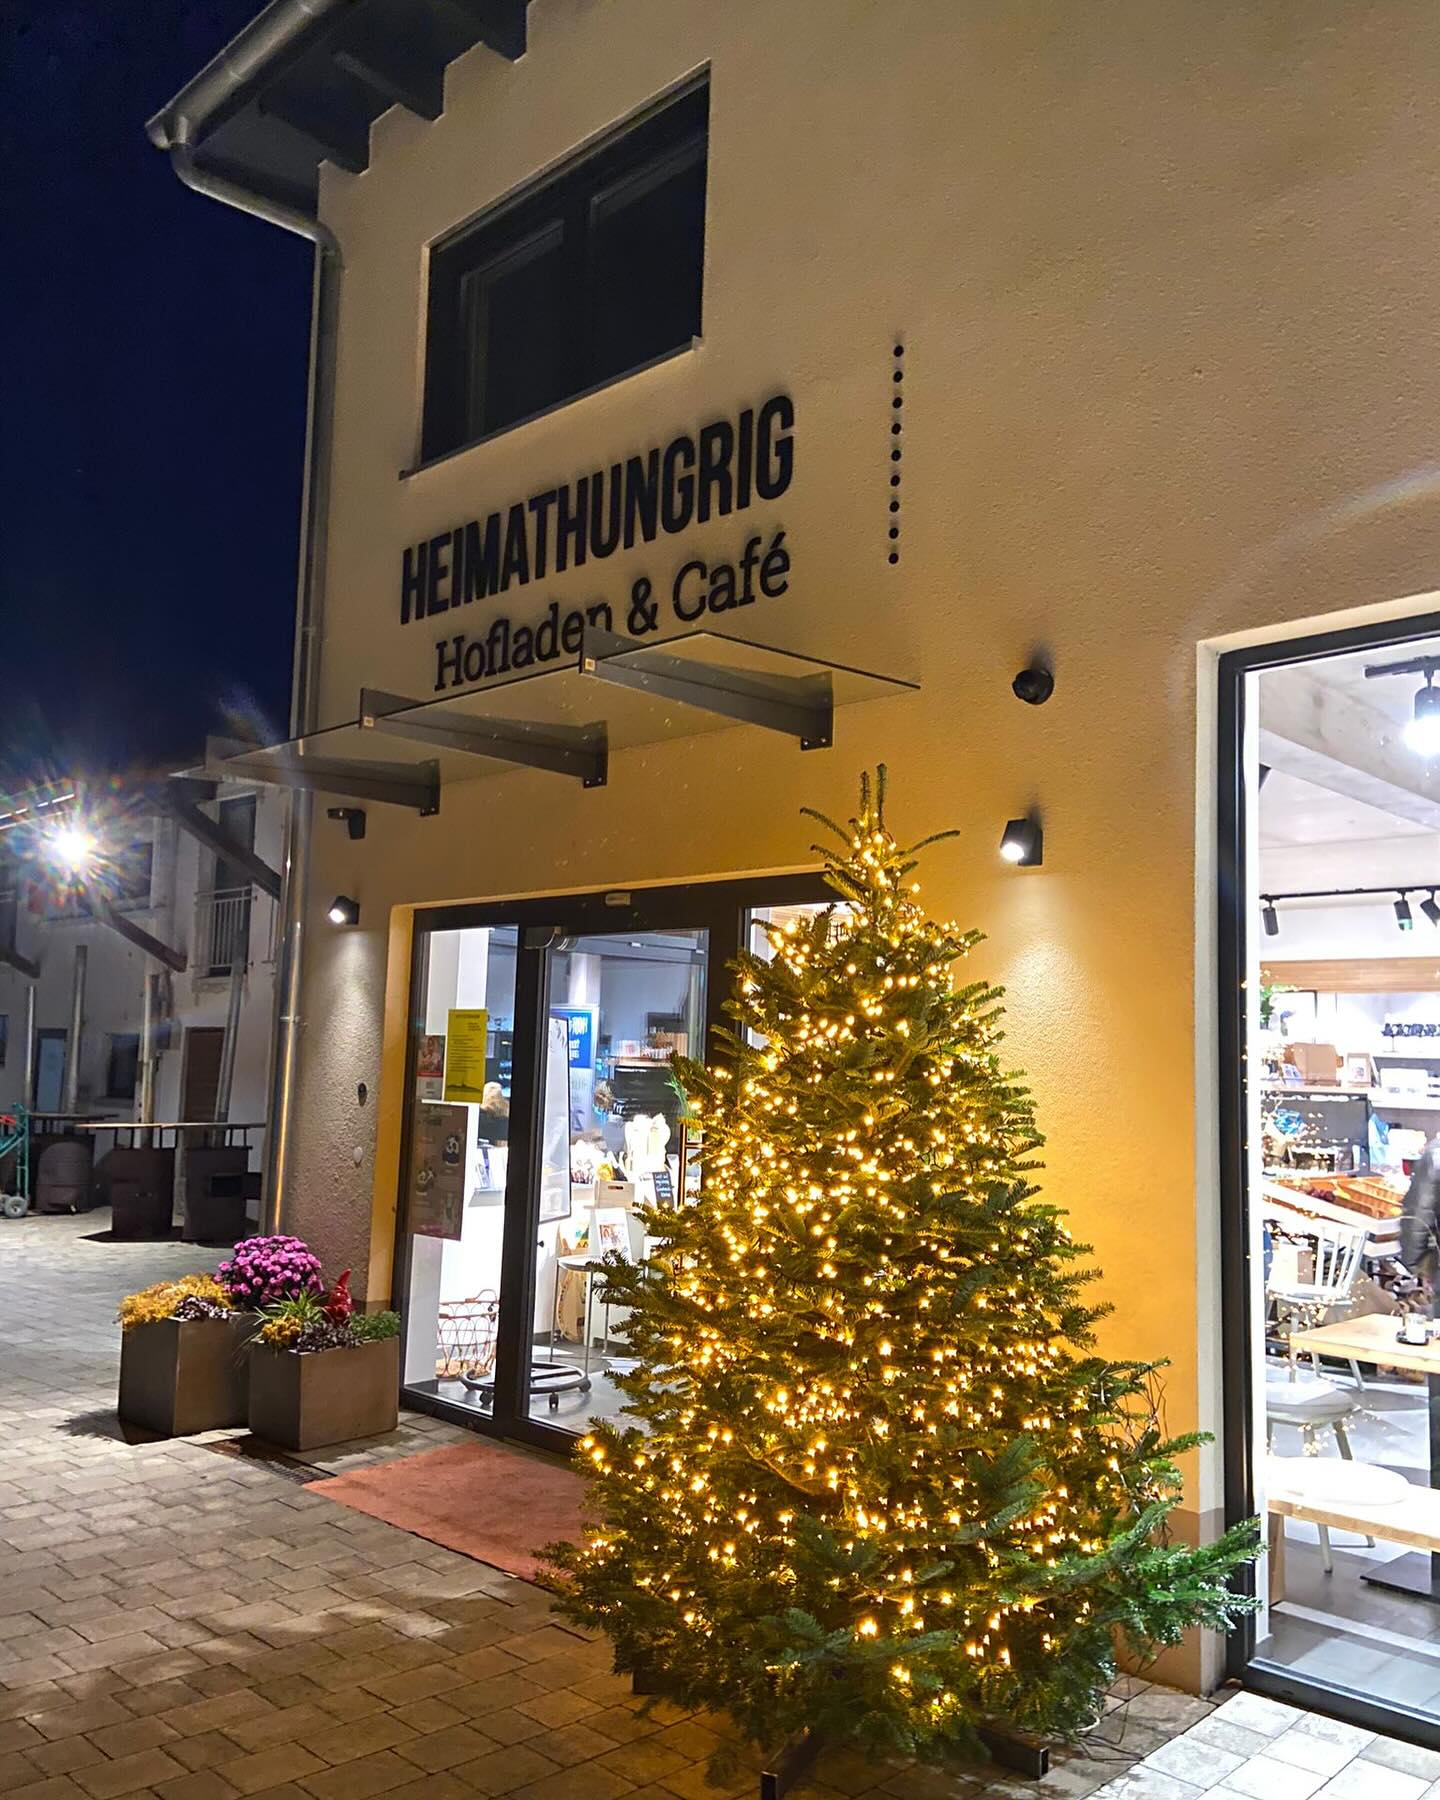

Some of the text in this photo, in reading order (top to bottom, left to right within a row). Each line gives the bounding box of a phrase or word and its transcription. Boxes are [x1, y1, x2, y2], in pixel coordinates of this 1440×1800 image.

[401, 395, 794, 625] HEIMATHUNGRIG
[434, 532, 791, 691] Hofladen & Café
